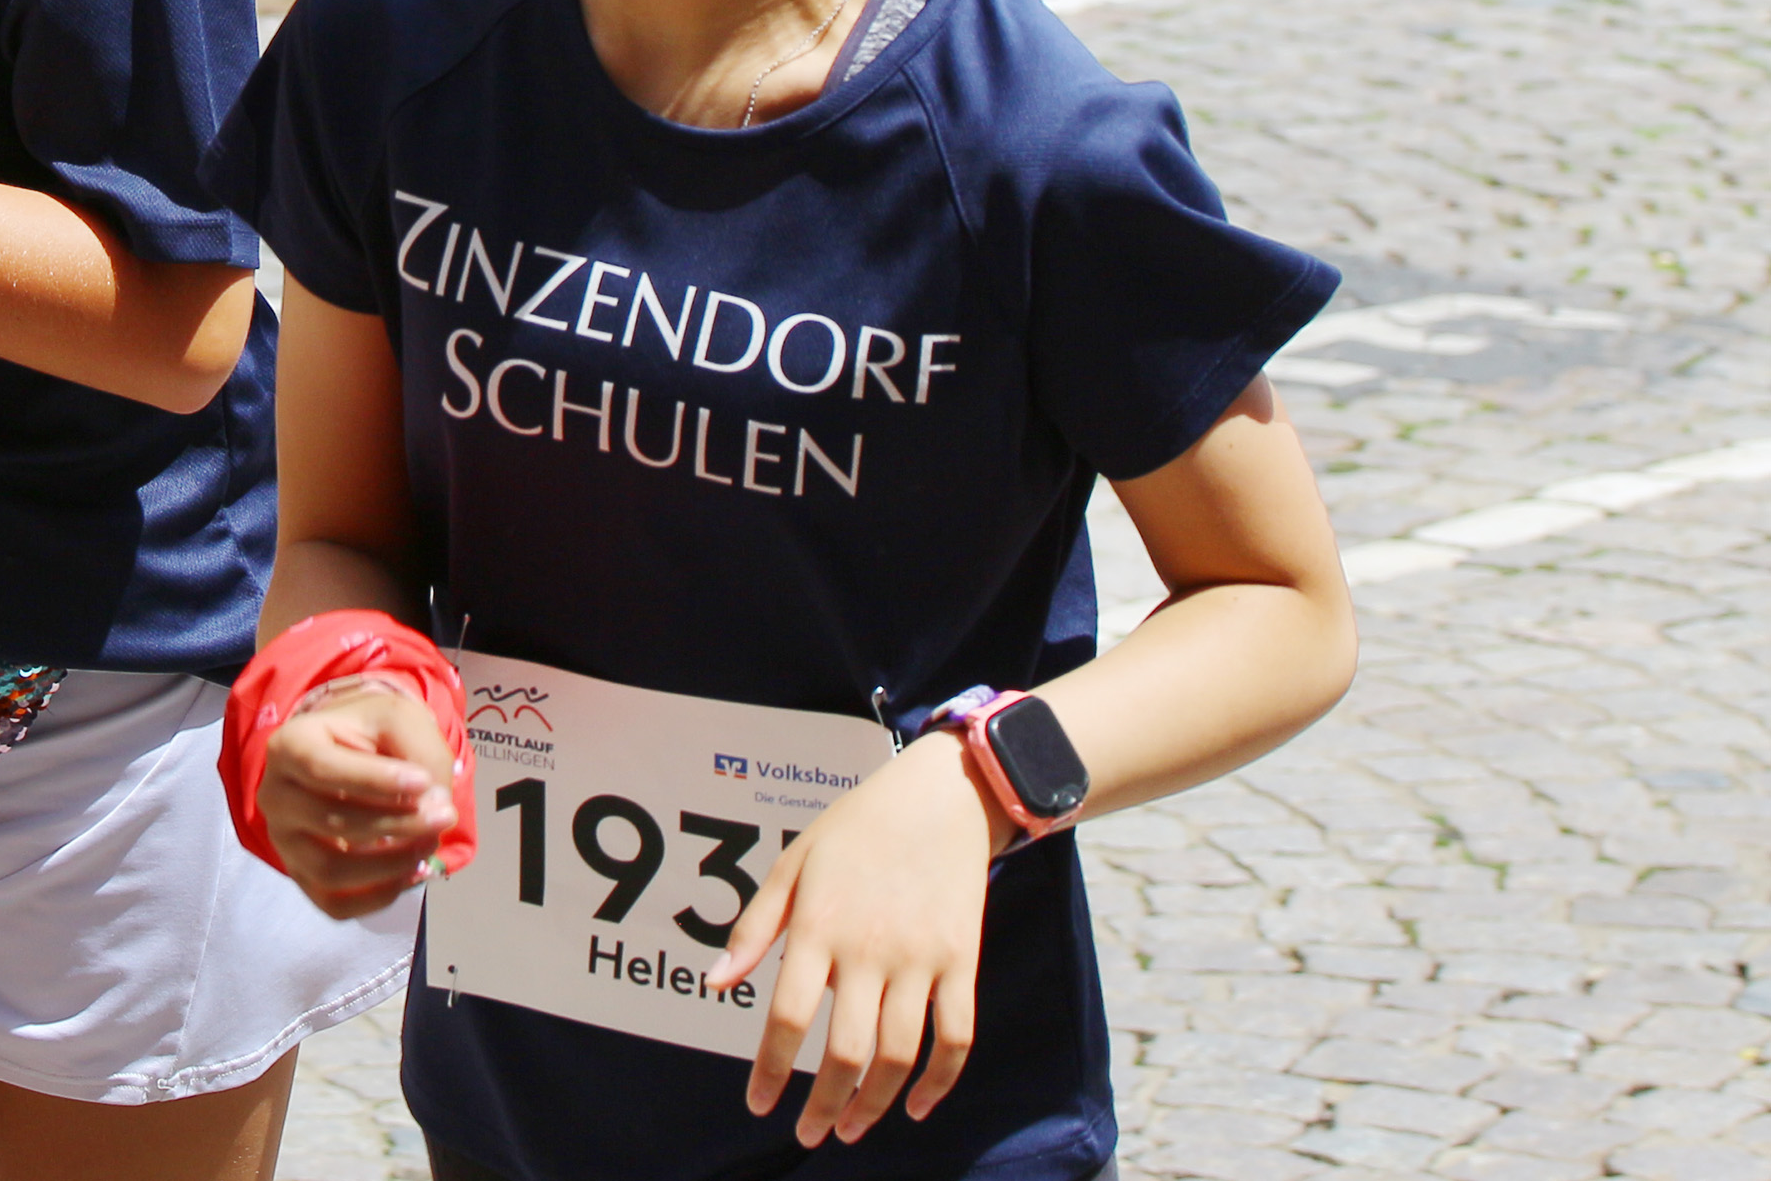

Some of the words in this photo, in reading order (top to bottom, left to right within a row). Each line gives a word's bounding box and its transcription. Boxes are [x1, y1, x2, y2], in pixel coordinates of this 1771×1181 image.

[395, 189, 962, 405] ZINZENDORF
[440, 328, 864, 498] SCHULEN
[467, 727, 555, 754] STADTLAUF
[495, 777, 802, 949] 193
